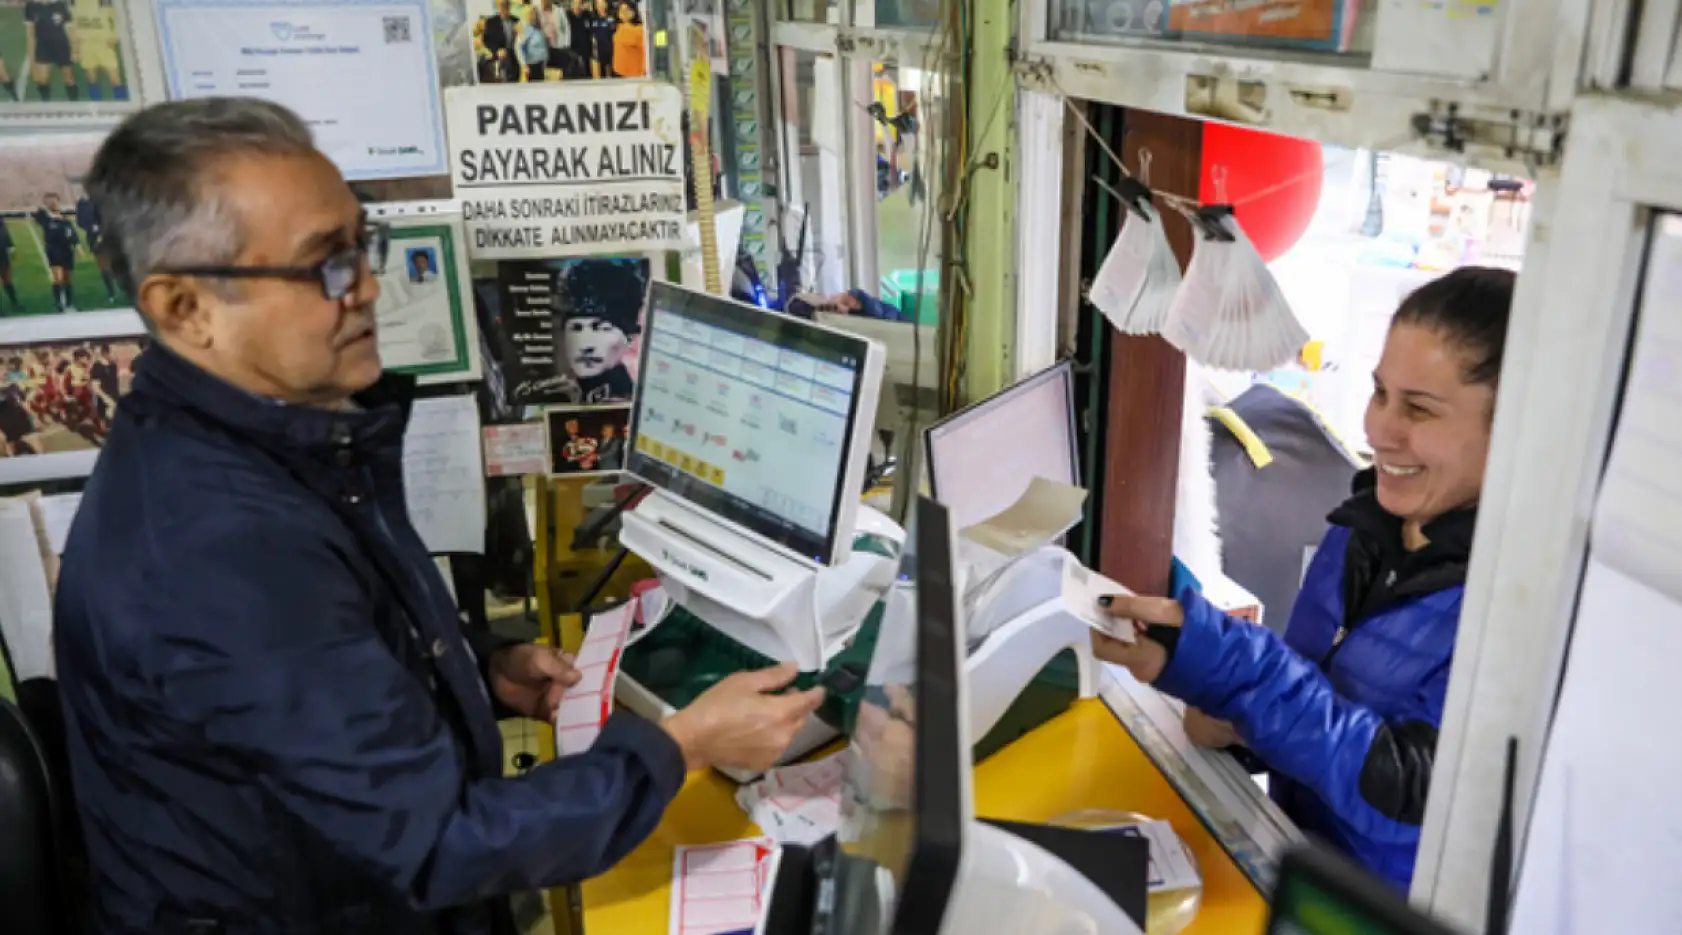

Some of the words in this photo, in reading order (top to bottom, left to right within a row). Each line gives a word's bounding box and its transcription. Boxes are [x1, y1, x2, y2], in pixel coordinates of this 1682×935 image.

[477, 101, 650, 136] PARANIZI
[460, 147, 590, 181] SAYARAK
[597, 144, 678, 177] ALINIZ
[463, 200, 506, 221] DAHA
[552, 219, 681, 245] ALINMAYACAKTIR
